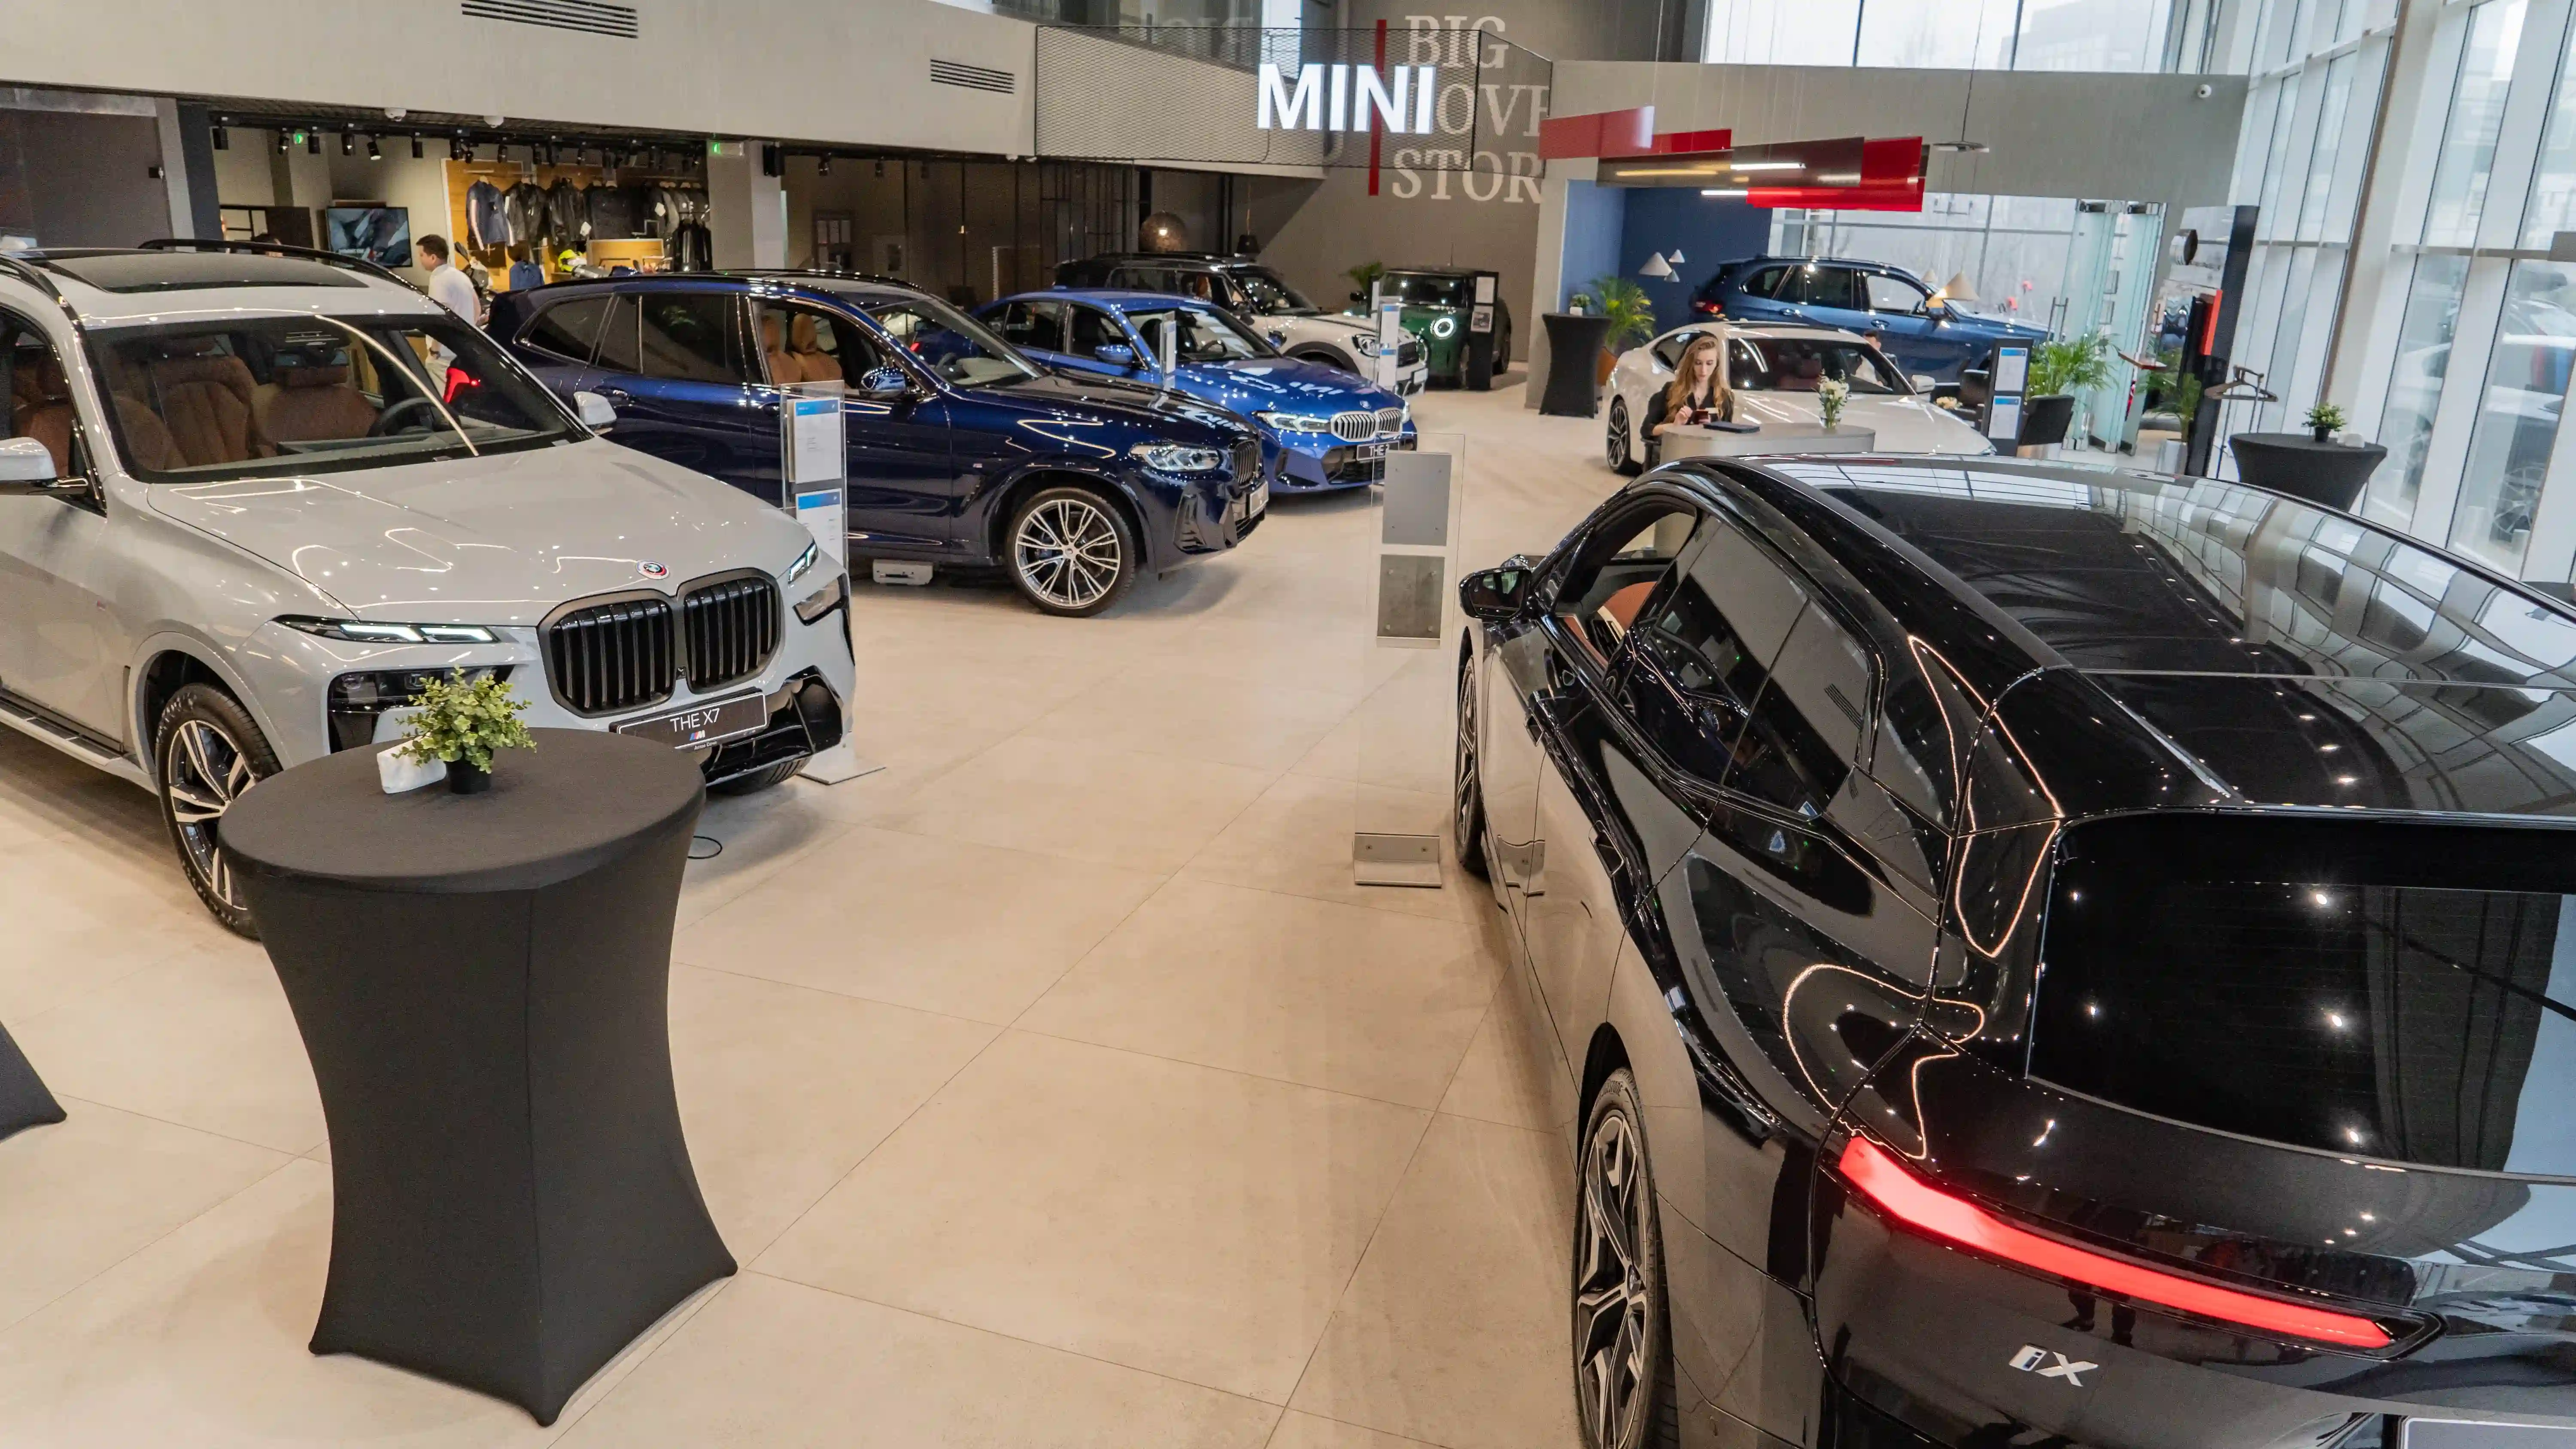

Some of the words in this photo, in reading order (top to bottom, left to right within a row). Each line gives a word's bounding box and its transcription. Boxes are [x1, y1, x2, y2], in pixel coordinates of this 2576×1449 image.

[1405, 15, 1509, 69] BIG
[1257, 62, 1437, 134] MINI
[1392, 149, 1542, 204] STOR
[1369, 444, 1385, 457] THE
[669, 712, 701, 732] THE
[702, 708, 720, 725] X7
[2008, 1343, 2099, 1387] iX
